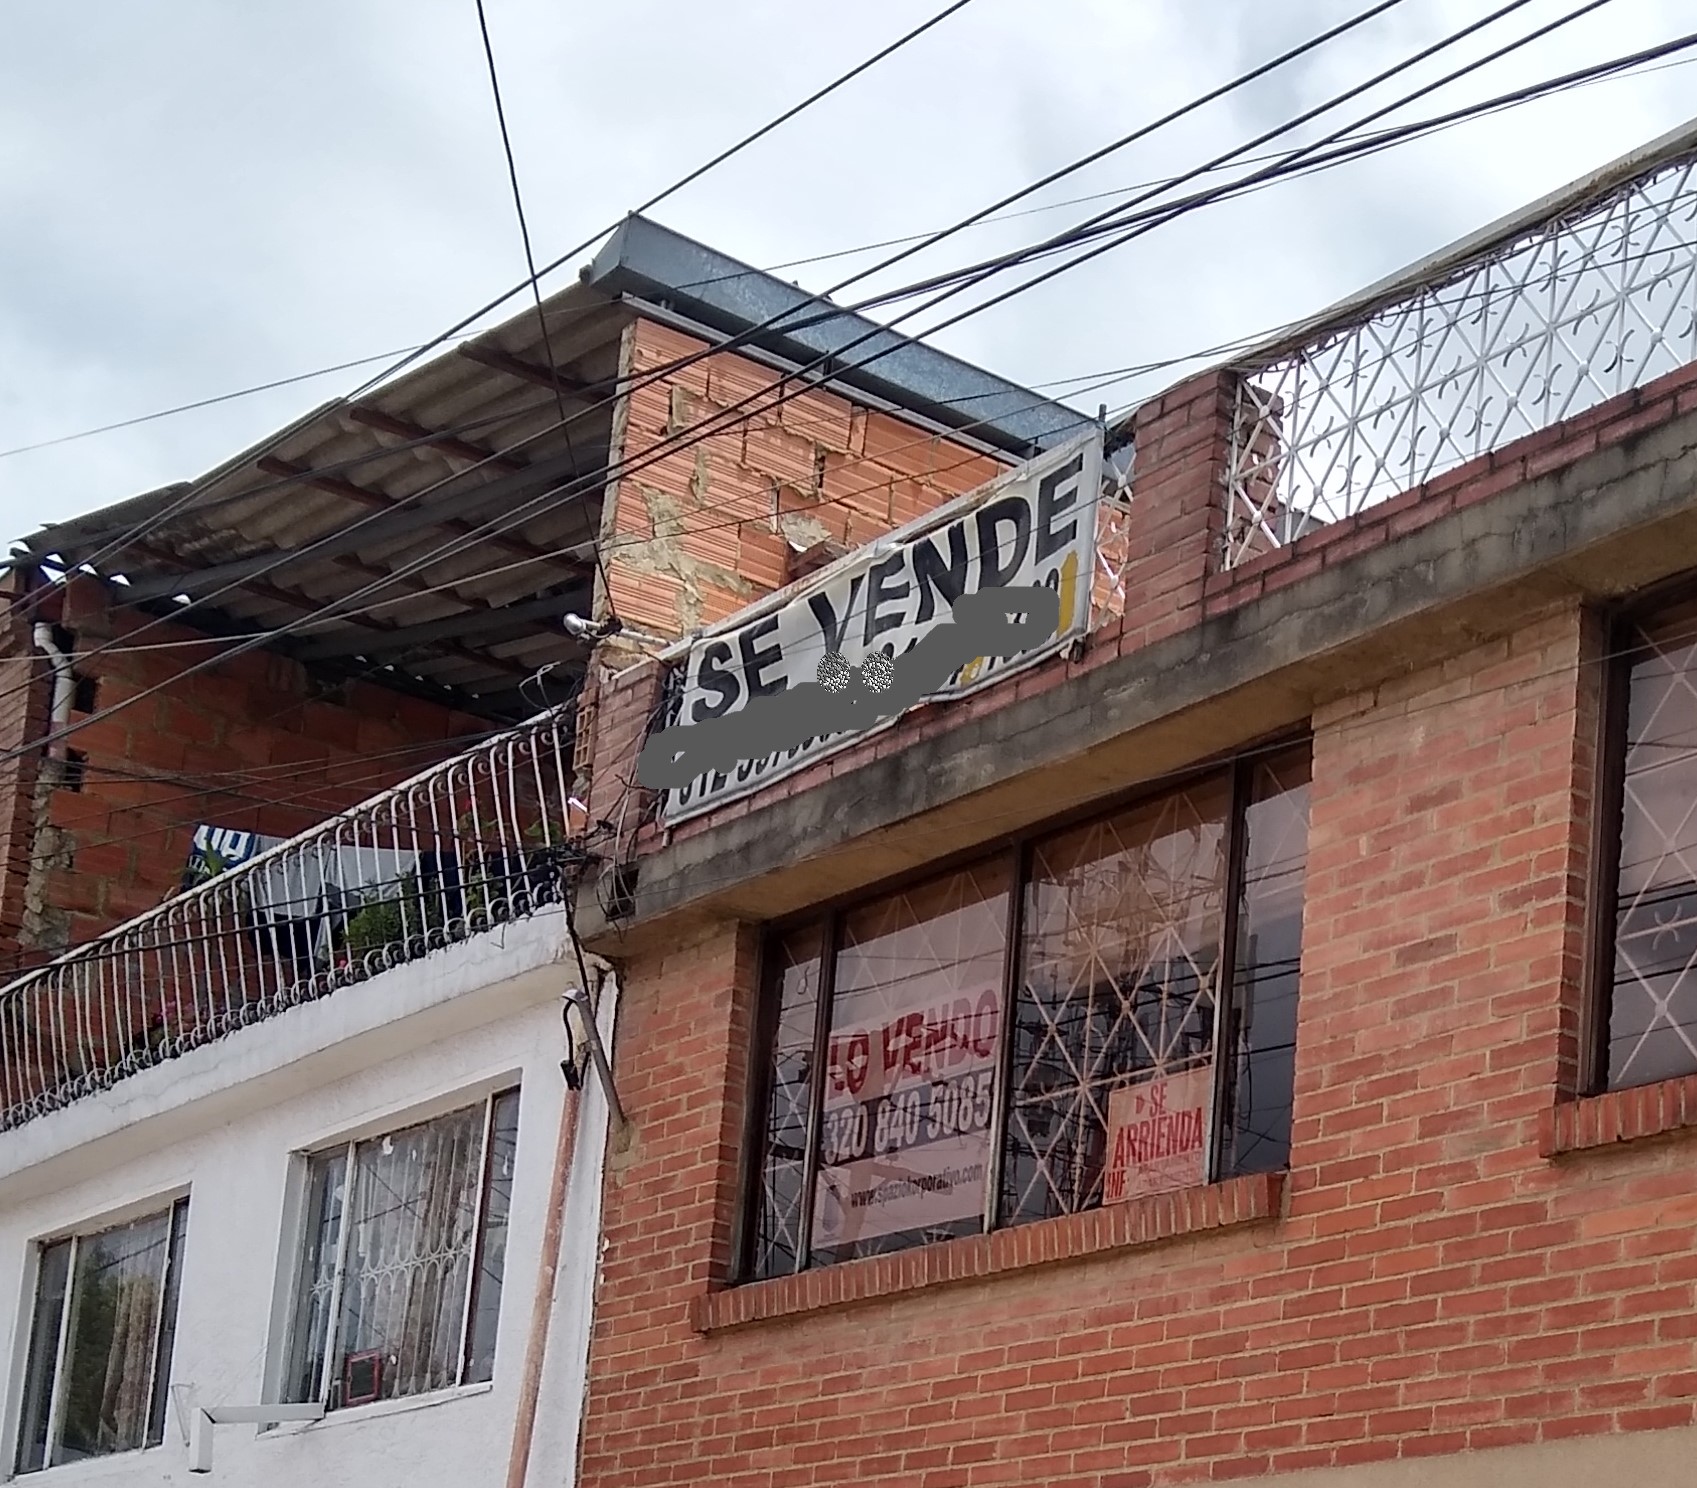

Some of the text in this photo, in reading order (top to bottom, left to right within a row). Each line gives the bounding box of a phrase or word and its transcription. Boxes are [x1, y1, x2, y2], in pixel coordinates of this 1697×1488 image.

[694, 453, 1083, 722] SE VENDE
[829, 989, 998, 1098] LO VENDO
[824, 1071, 993, 1164] 320 840 5085
[1112, 1107, 1203, 1169] ARRIENDA
[1149, 1082, 1168, 1117] SE
